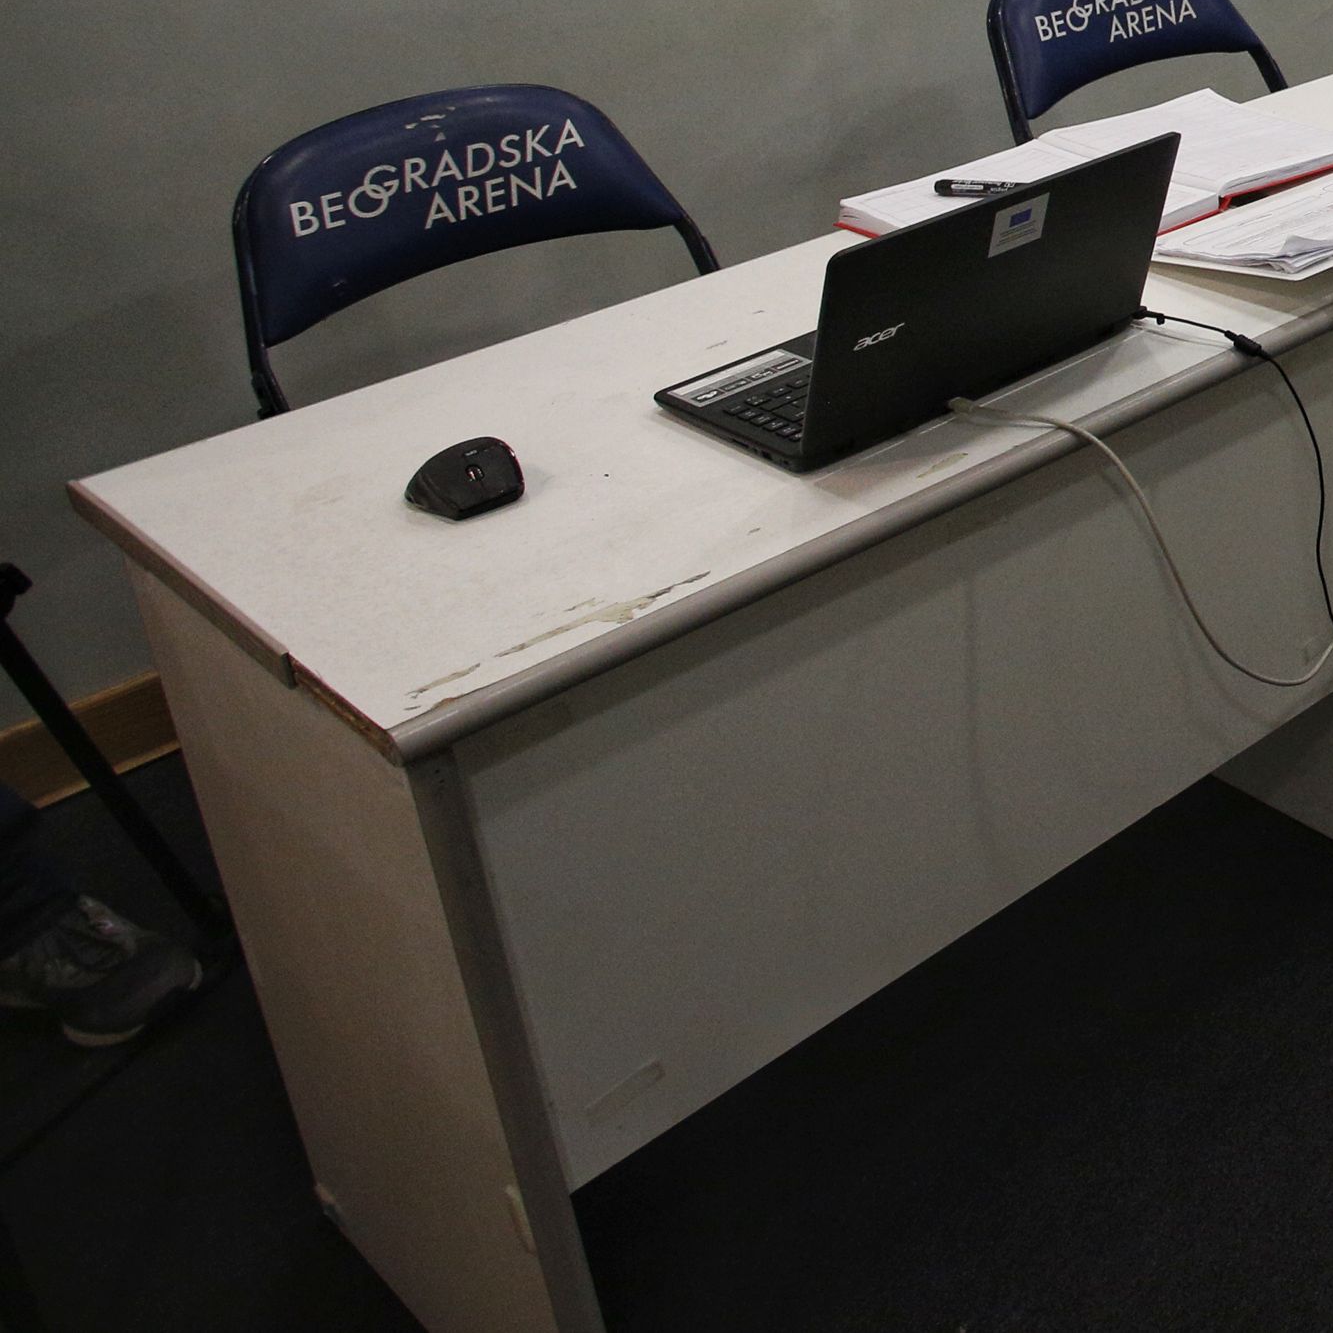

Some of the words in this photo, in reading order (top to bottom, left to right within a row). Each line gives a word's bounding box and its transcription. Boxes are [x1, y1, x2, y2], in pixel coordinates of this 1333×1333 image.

[288, 118, 586, 238] BEOGRADSKA
[423, 158, 579, 230] ARENA
[852, 322, 906, 352] acer
